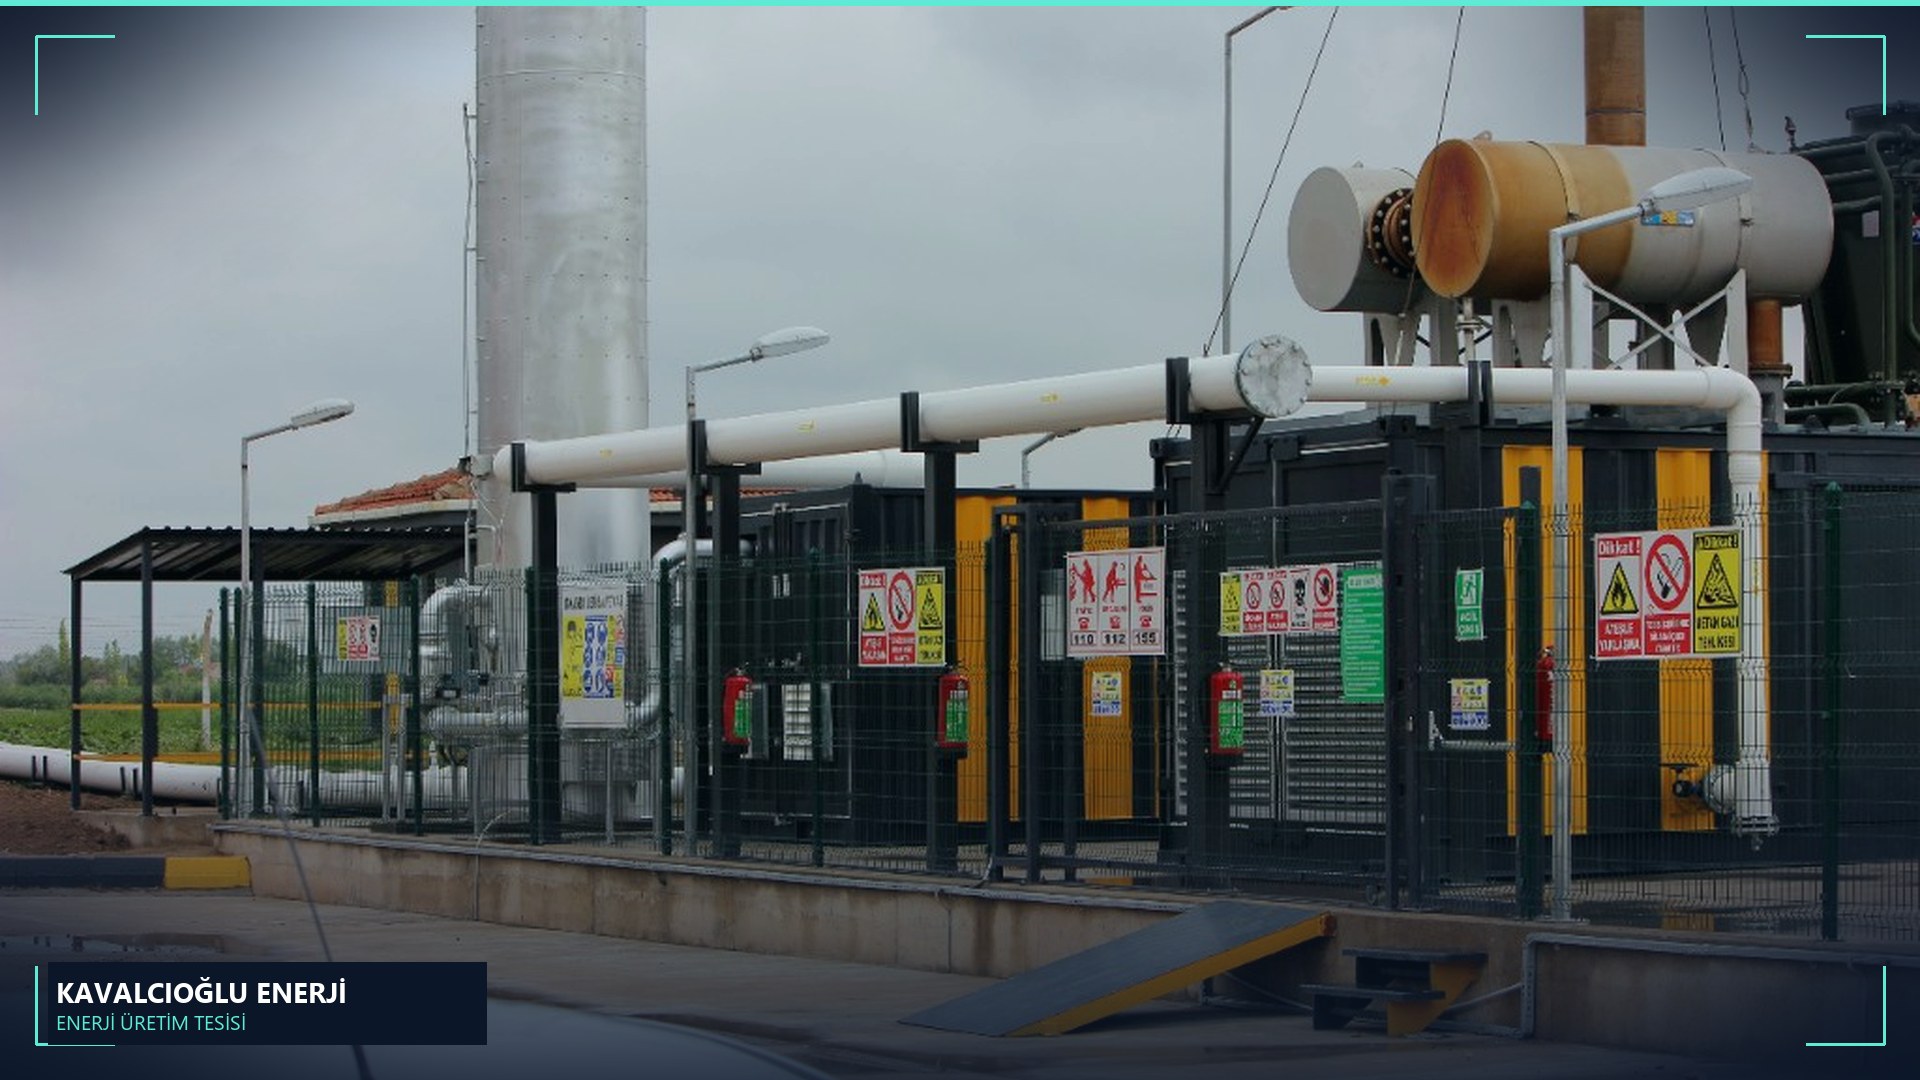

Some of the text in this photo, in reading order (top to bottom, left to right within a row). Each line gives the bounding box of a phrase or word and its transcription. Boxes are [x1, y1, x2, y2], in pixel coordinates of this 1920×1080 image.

[1074, 634, 1094, 645] 110
[1104, 634, 1126, 645] 112
[1135, 632, 1156, 644] 155
